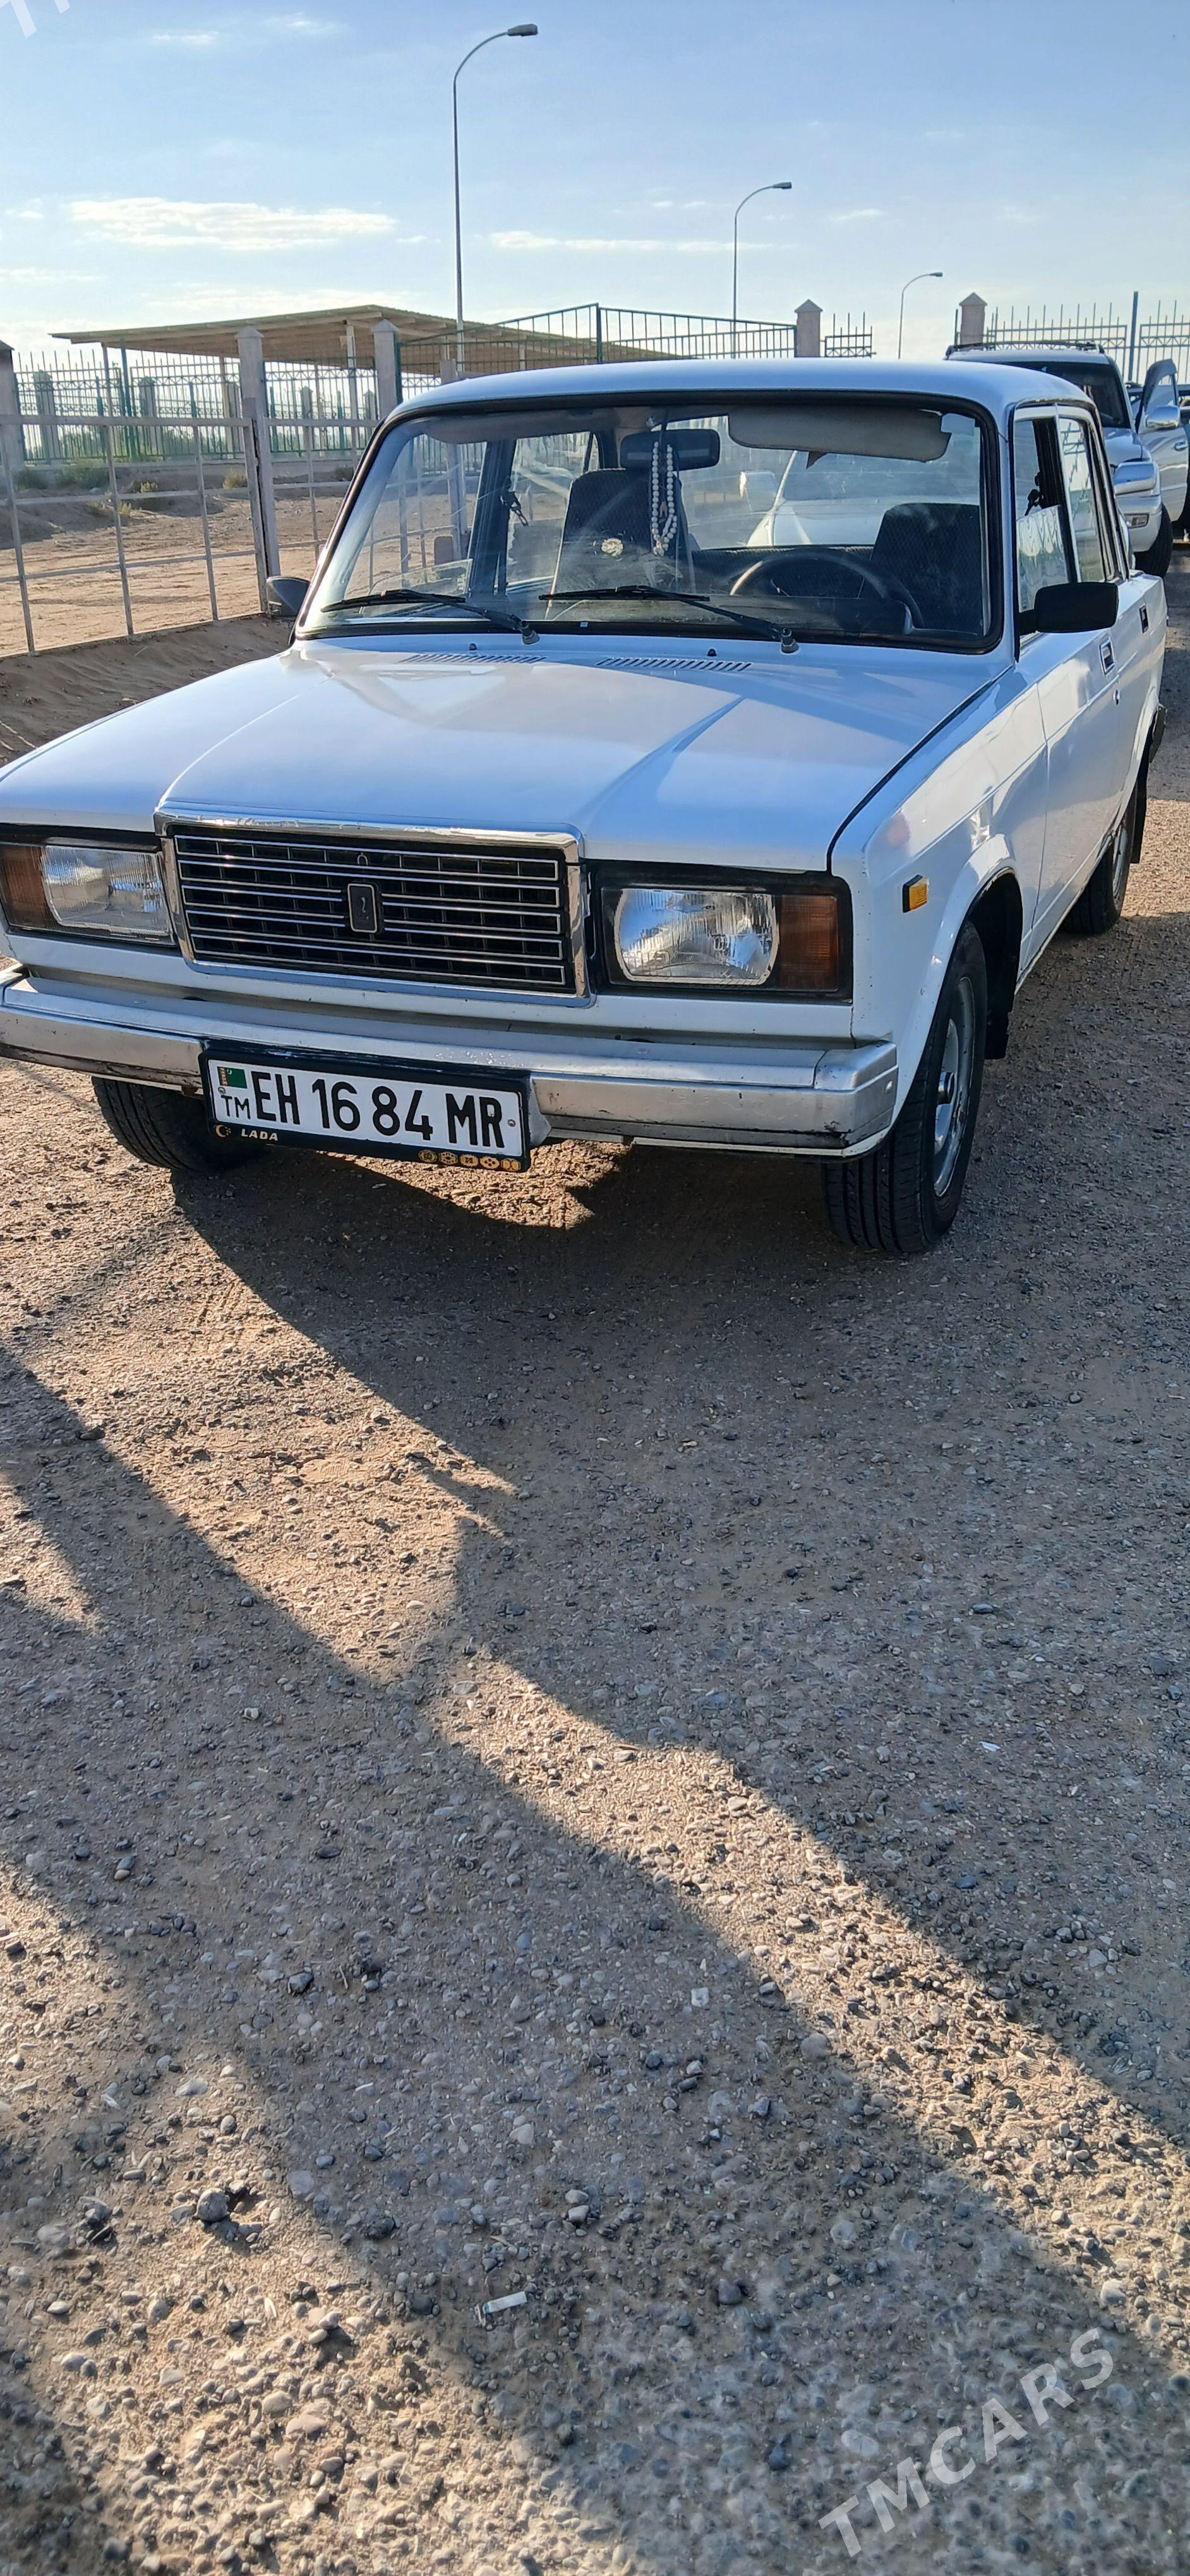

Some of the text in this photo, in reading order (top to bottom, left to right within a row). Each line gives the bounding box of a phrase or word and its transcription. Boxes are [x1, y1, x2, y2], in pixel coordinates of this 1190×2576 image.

[220, 1095, 251, 1120] TM
[250, 1071, 301, 1125] EH
[445, 1093, 505, 1148] MR
[241, 1128, 279, 1142] LADA
